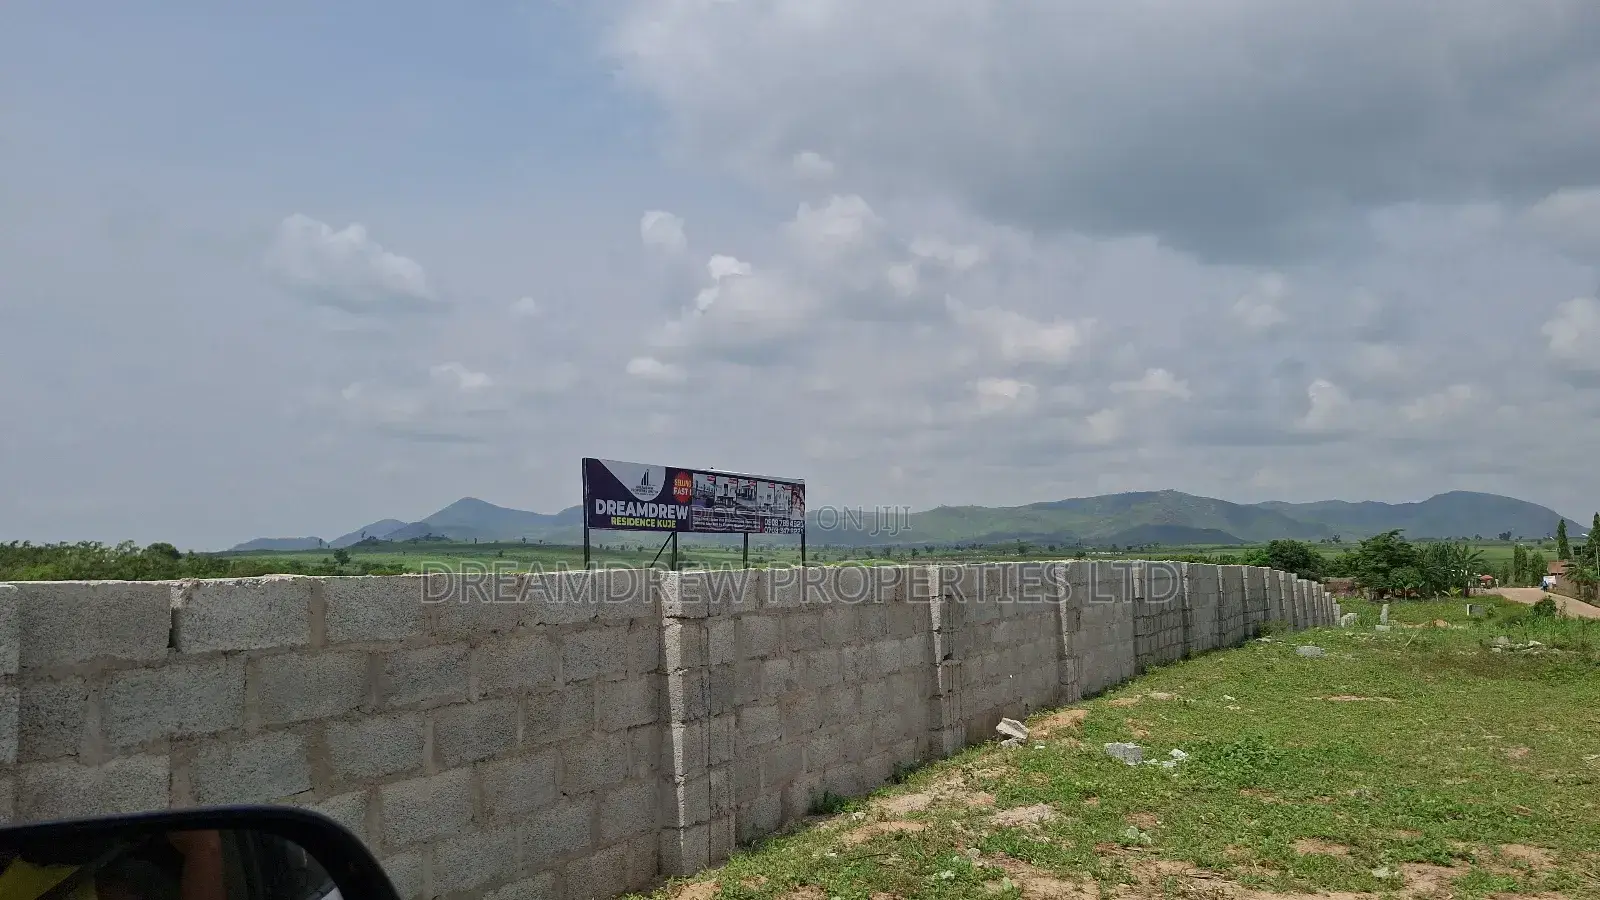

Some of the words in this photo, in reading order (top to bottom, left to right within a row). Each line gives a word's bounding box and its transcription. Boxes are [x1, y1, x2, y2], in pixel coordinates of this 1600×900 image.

[595, 498, 689, 520] DREAMDREW
[610, 516, 656, 528] RESIDENCE
[657, 519, 677, 529] KUJE
